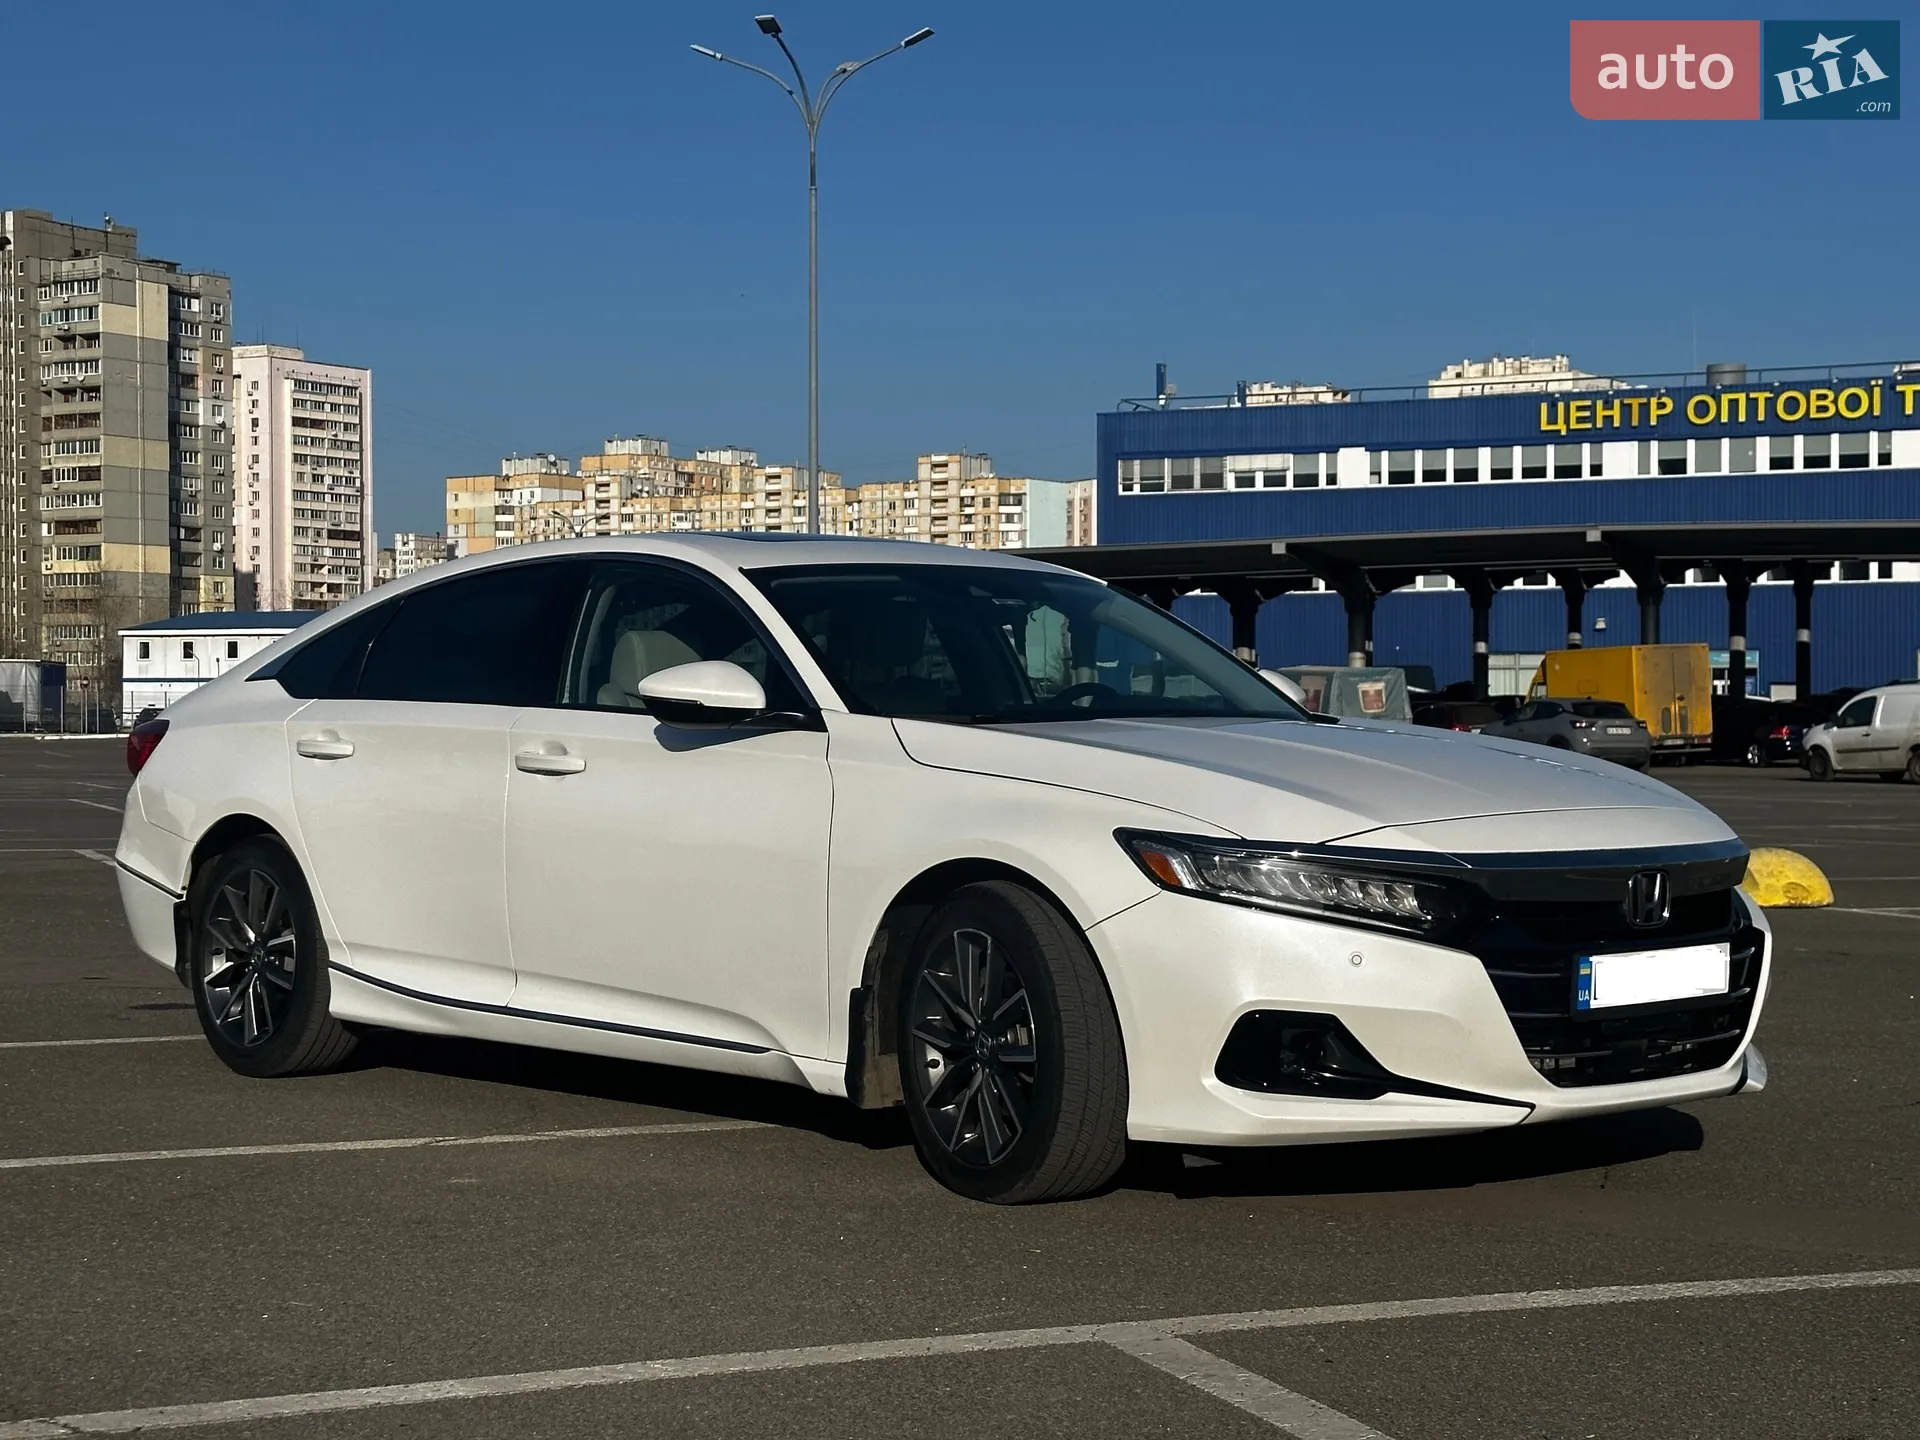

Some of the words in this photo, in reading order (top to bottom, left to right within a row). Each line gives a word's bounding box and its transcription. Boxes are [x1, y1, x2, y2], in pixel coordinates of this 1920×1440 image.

[1540, 397, 1674, 435] ЦЕНТР
[1686, 379, 1882, 426] ОПТОВОЇ
[1578, 989, 1590, 1001] UA
